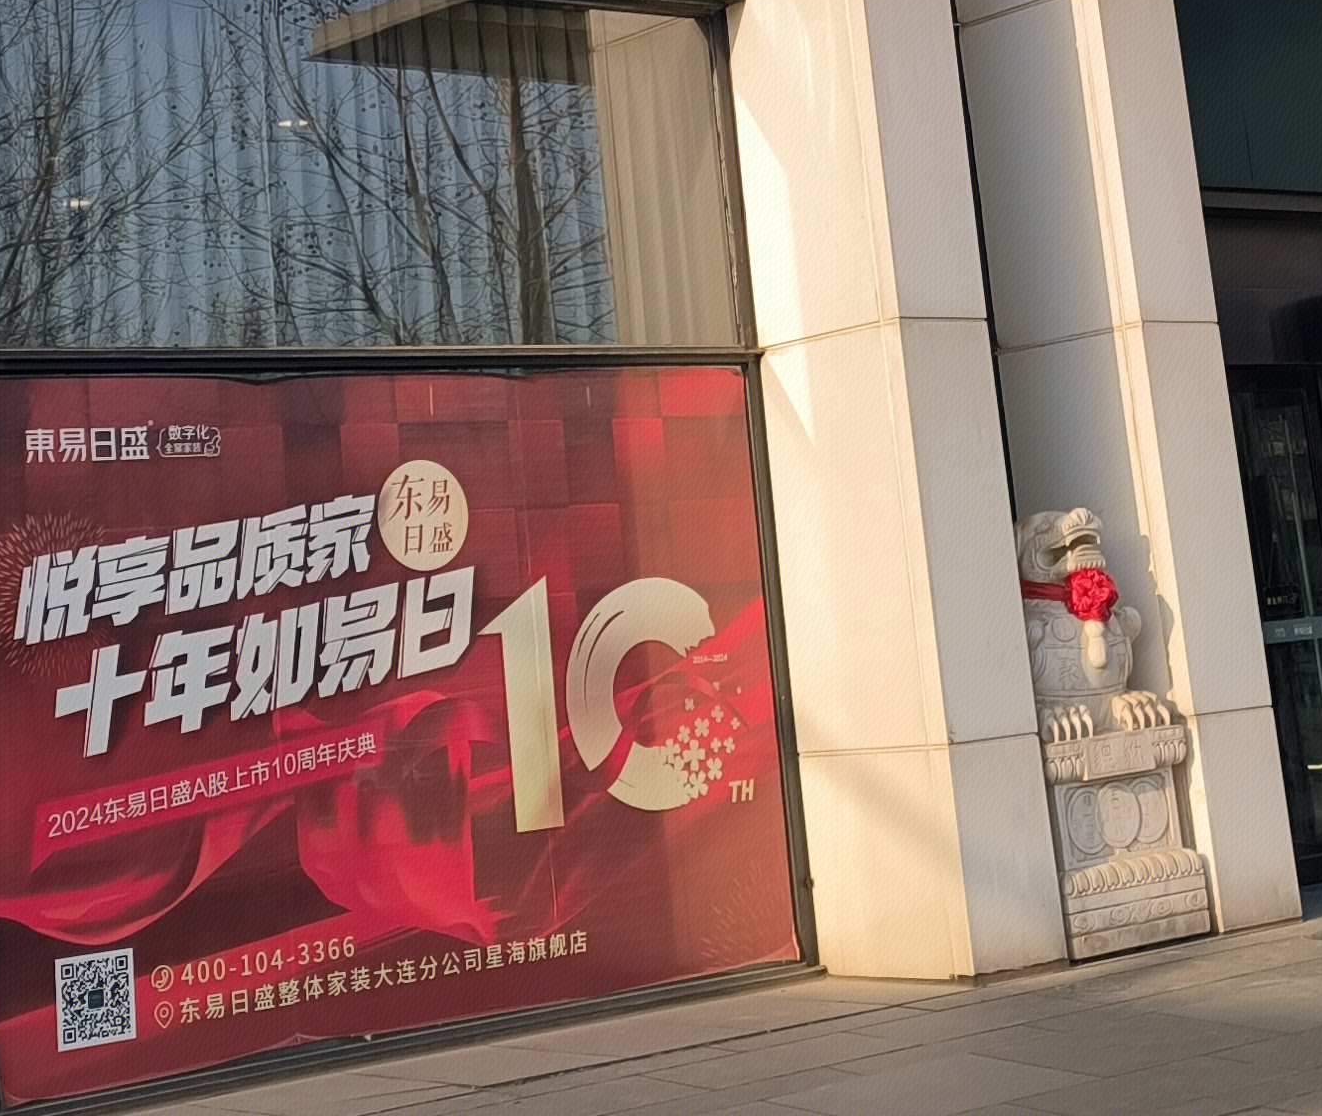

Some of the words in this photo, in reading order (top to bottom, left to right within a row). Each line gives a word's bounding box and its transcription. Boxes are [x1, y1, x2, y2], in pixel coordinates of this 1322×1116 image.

[168, 424, 210, 441] 数字化
[388, 474, 450, 523] 东易
[404, 521, 454, 557] 日盛
[13, 494, 377, 646] 悦享品质家
[53, 565, 475, 759] 十年如易日
[47, 731, 378, 838] 2024东易日盛A股上市10周年庆典
[728, 778, 755, 804] TH
[179, 929, 588, 1025] 东易日盛整体家装大连分公司星海旗舰店
[180, 935, 356, 987] 400-104-3366
